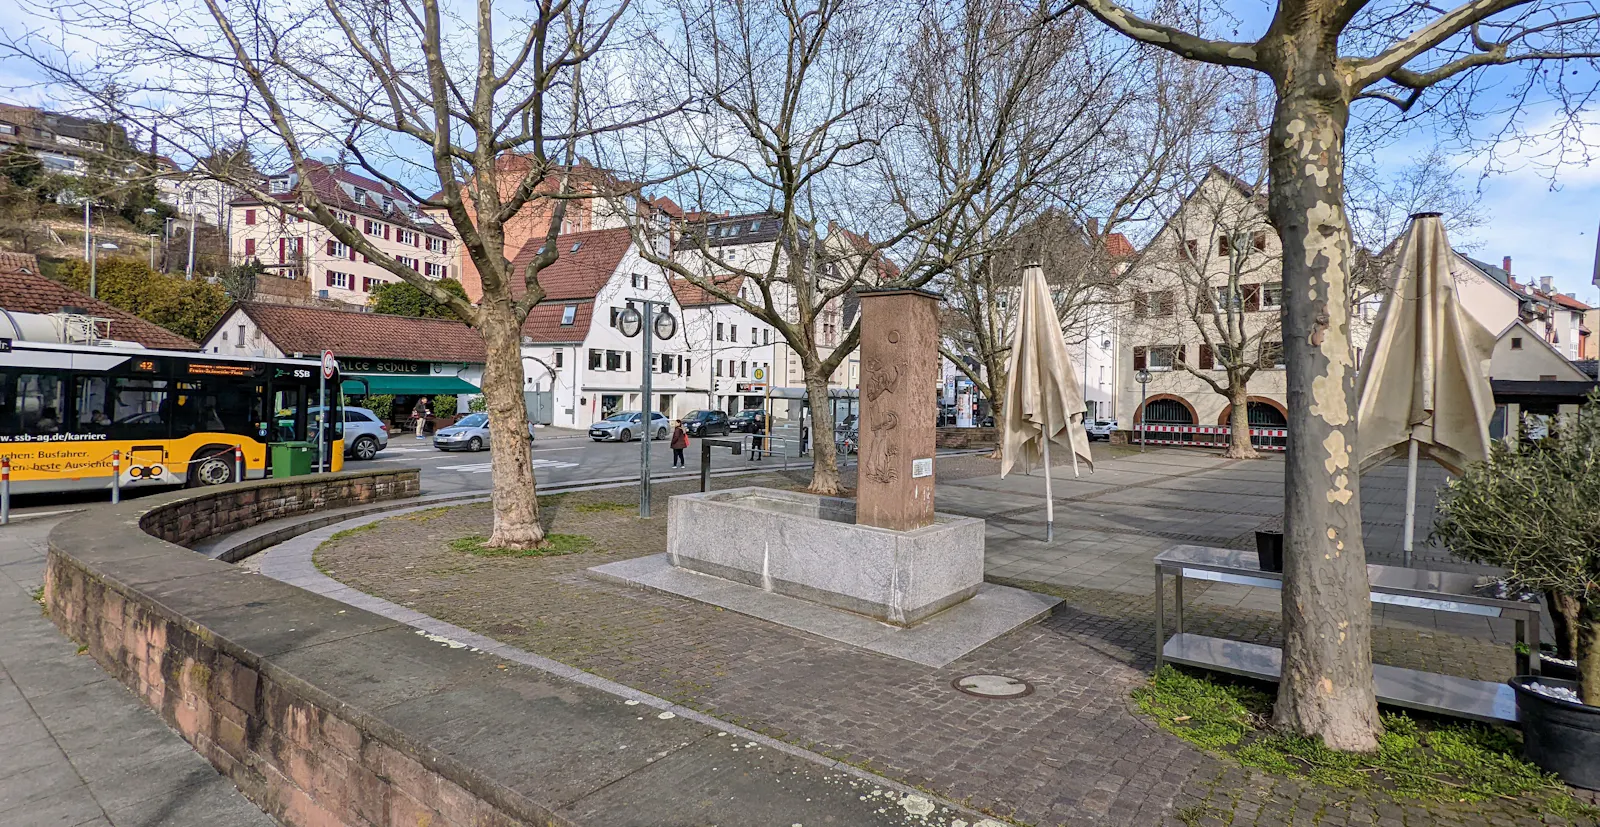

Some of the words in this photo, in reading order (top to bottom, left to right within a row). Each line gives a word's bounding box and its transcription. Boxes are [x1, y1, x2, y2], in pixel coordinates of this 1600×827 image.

[140, 361, 153, 370] 42
[293, 369, 311, 378] SSB
[38, 450, 90, 459] Busfahrer.
[33, 462, 61, 470] beste
